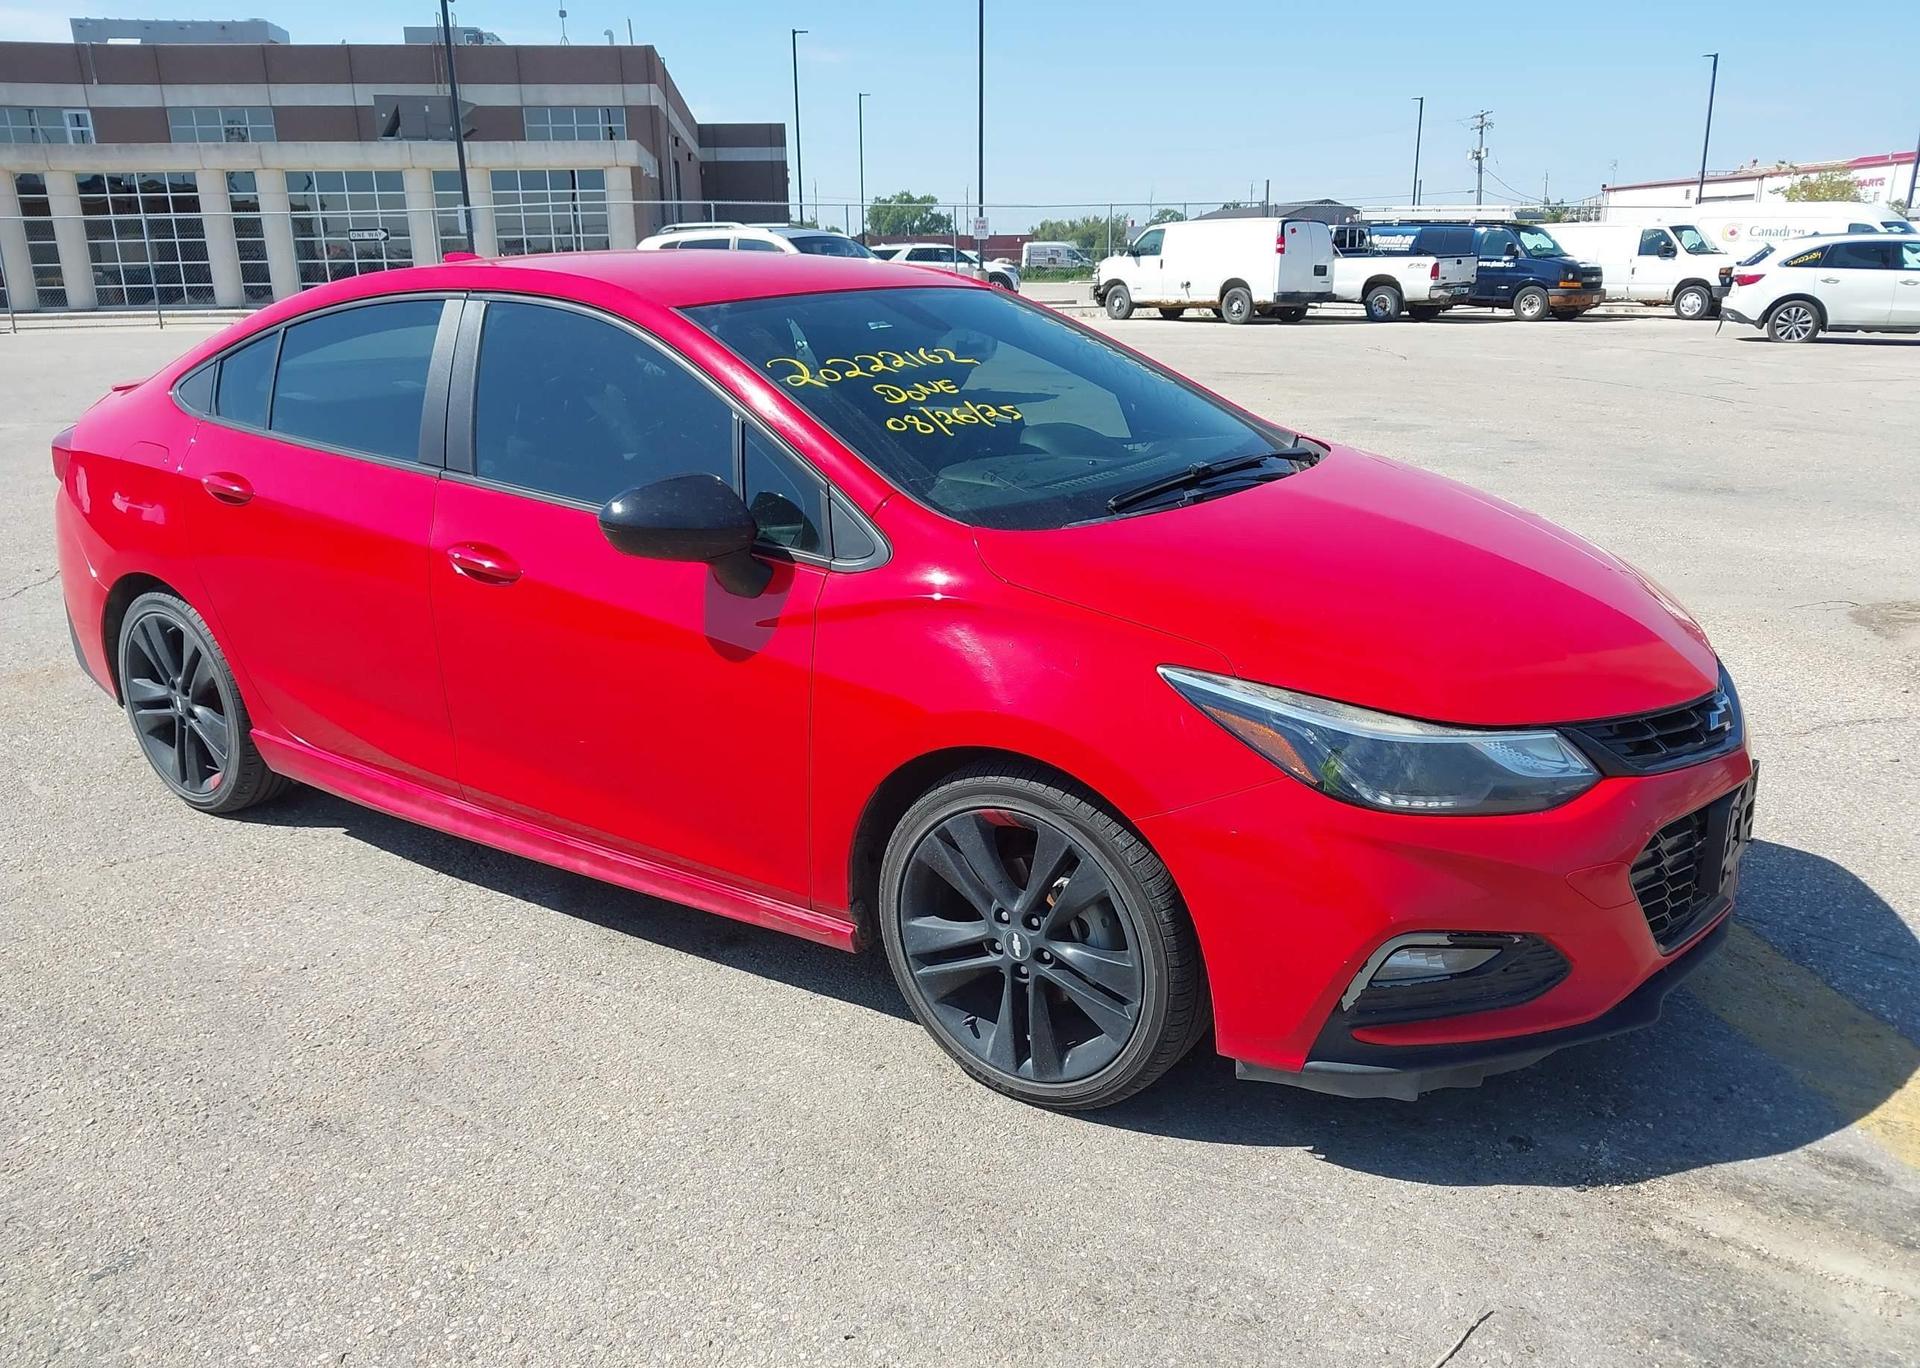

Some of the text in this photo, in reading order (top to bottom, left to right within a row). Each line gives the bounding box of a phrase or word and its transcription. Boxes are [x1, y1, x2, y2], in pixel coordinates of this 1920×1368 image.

[351, 231, 364, 239] ONE
[766, 347, 982, 388] 20222162
[873, 379, 960, 404] DONE
[886, 400, 1023, 437] 08/26/25
